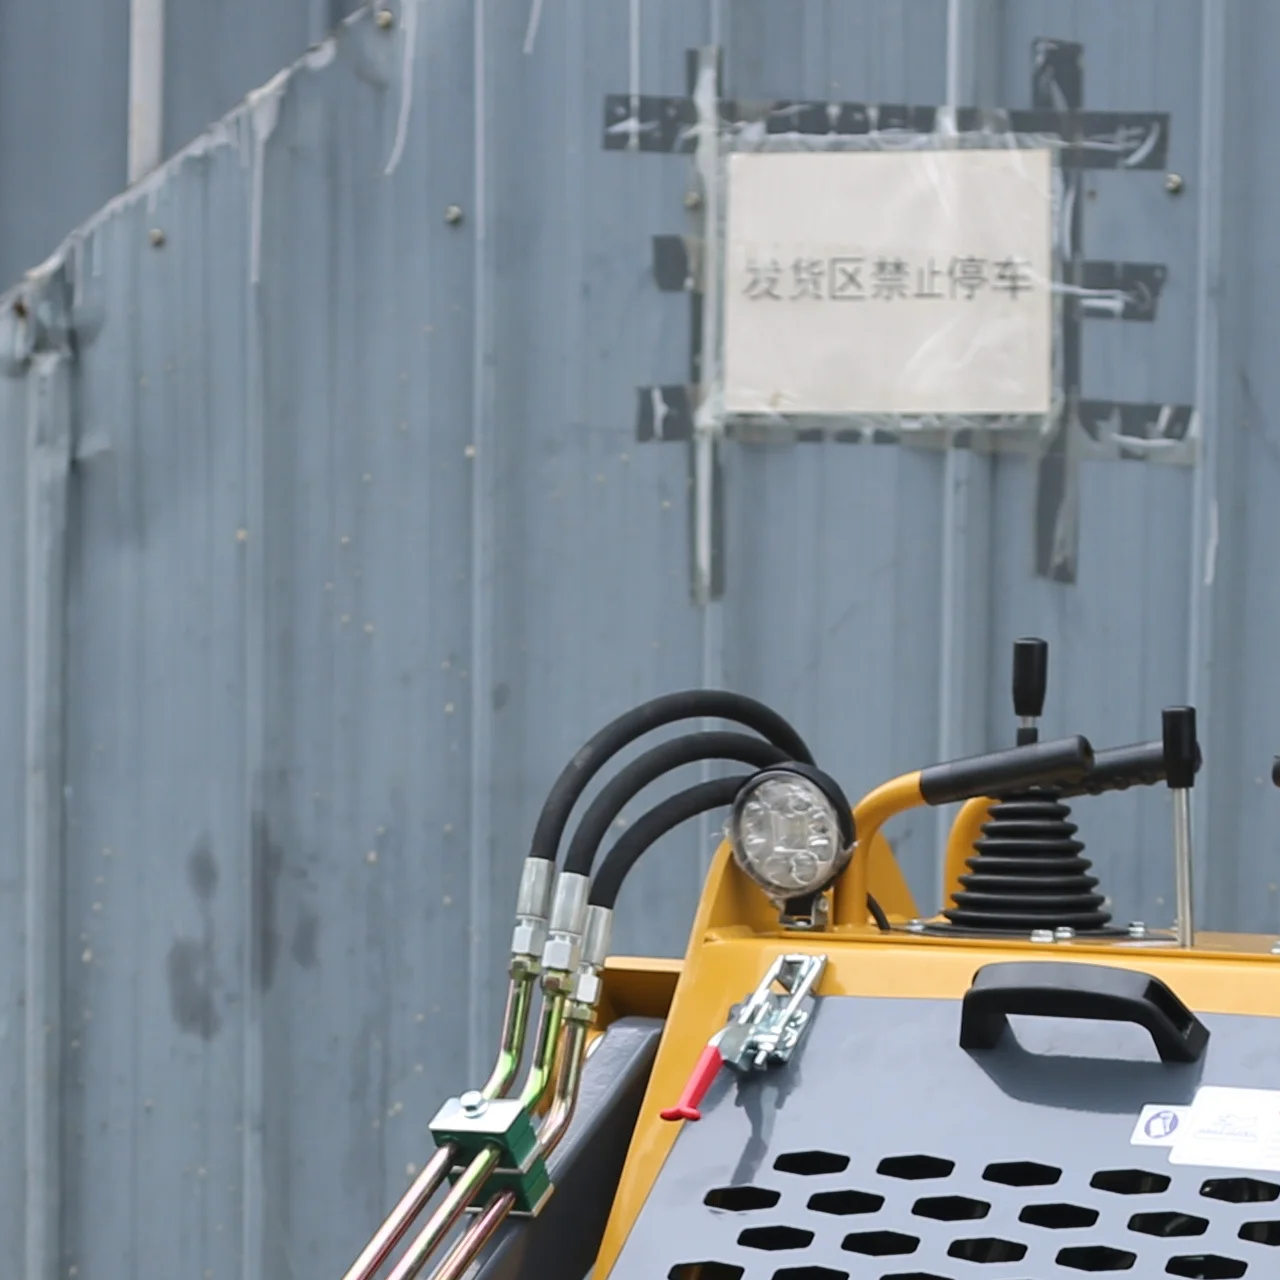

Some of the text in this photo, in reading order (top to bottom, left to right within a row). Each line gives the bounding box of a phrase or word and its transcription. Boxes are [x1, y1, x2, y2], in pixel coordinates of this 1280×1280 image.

[741, 253, 1035, 302] 发货区禁止停车
